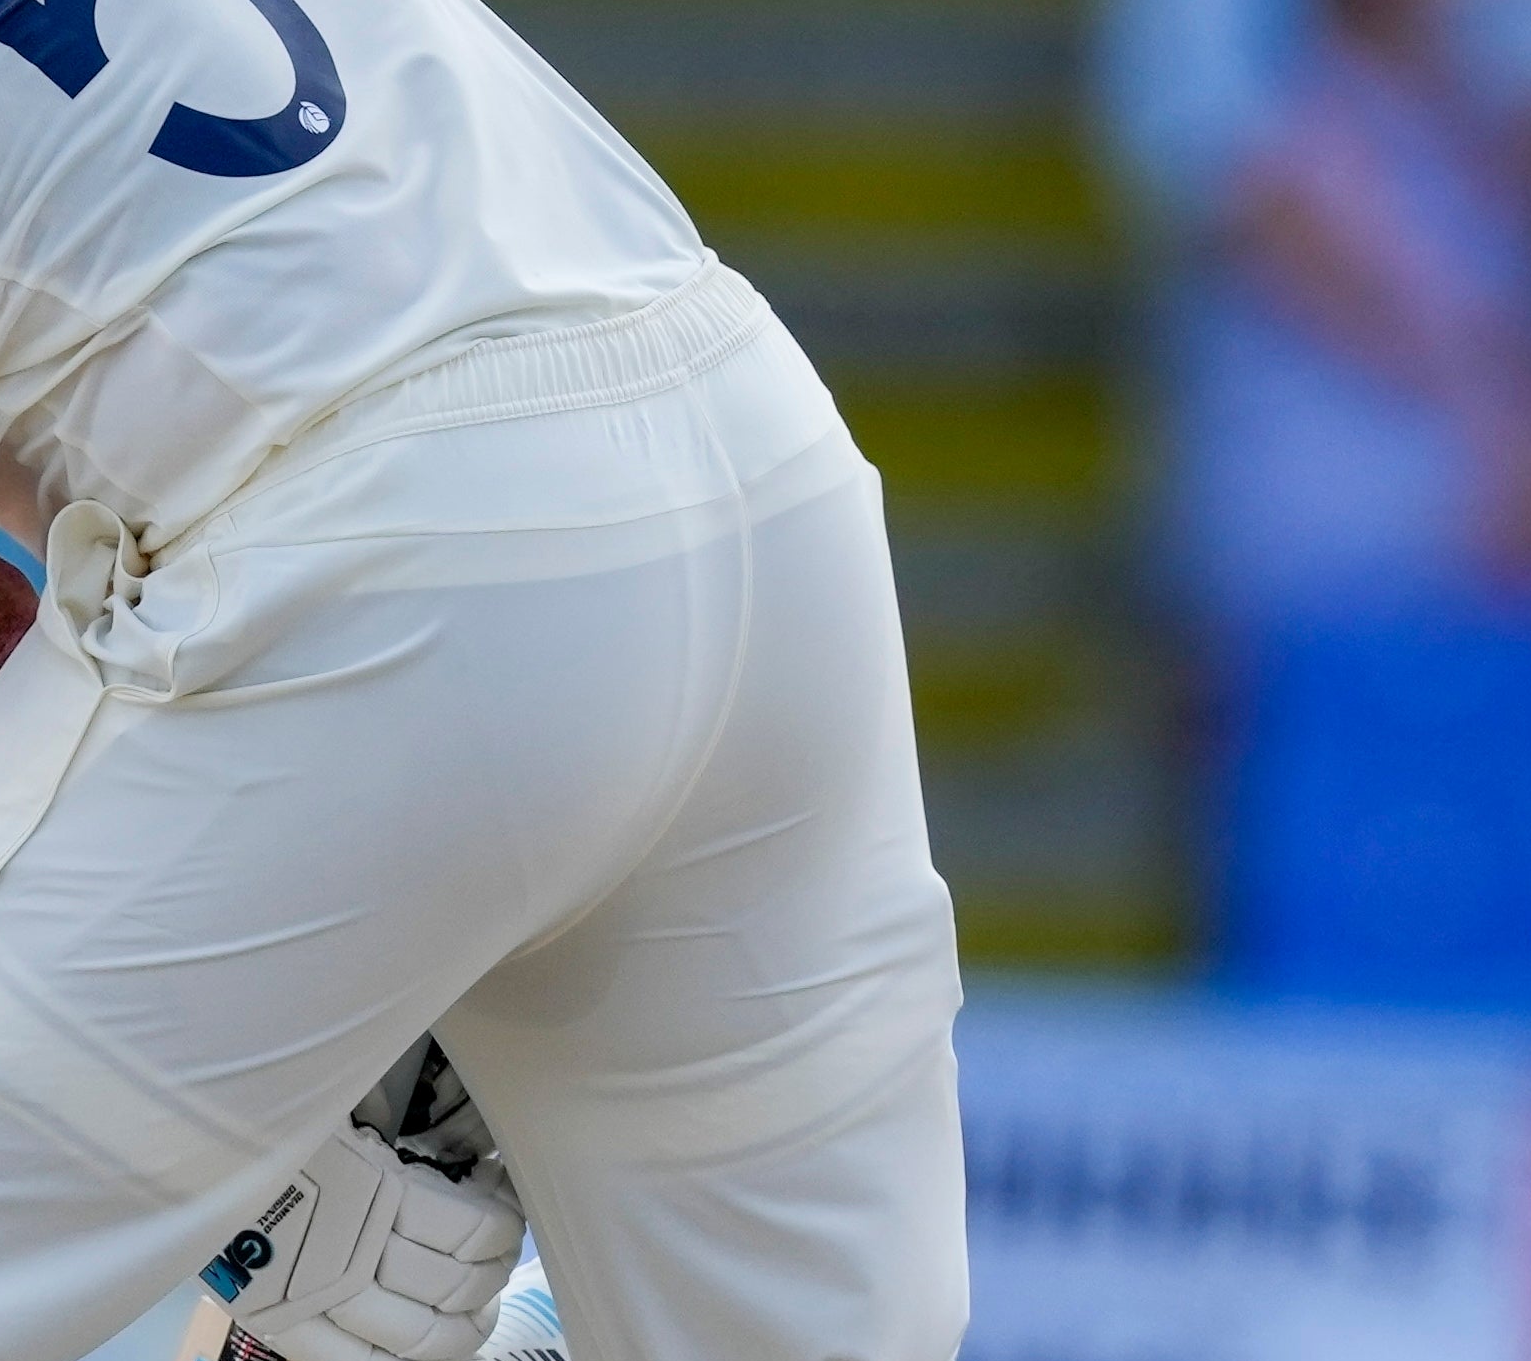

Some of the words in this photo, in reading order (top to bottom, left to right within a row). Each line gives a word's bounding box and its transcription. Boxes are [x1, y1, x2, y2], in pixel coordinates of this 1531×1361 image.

[256, 1183, 297, 1227] ORIGINAL
[263, 1190, 305, 1235] DIAMOND
[198, 1229, 274, 1304] GM
